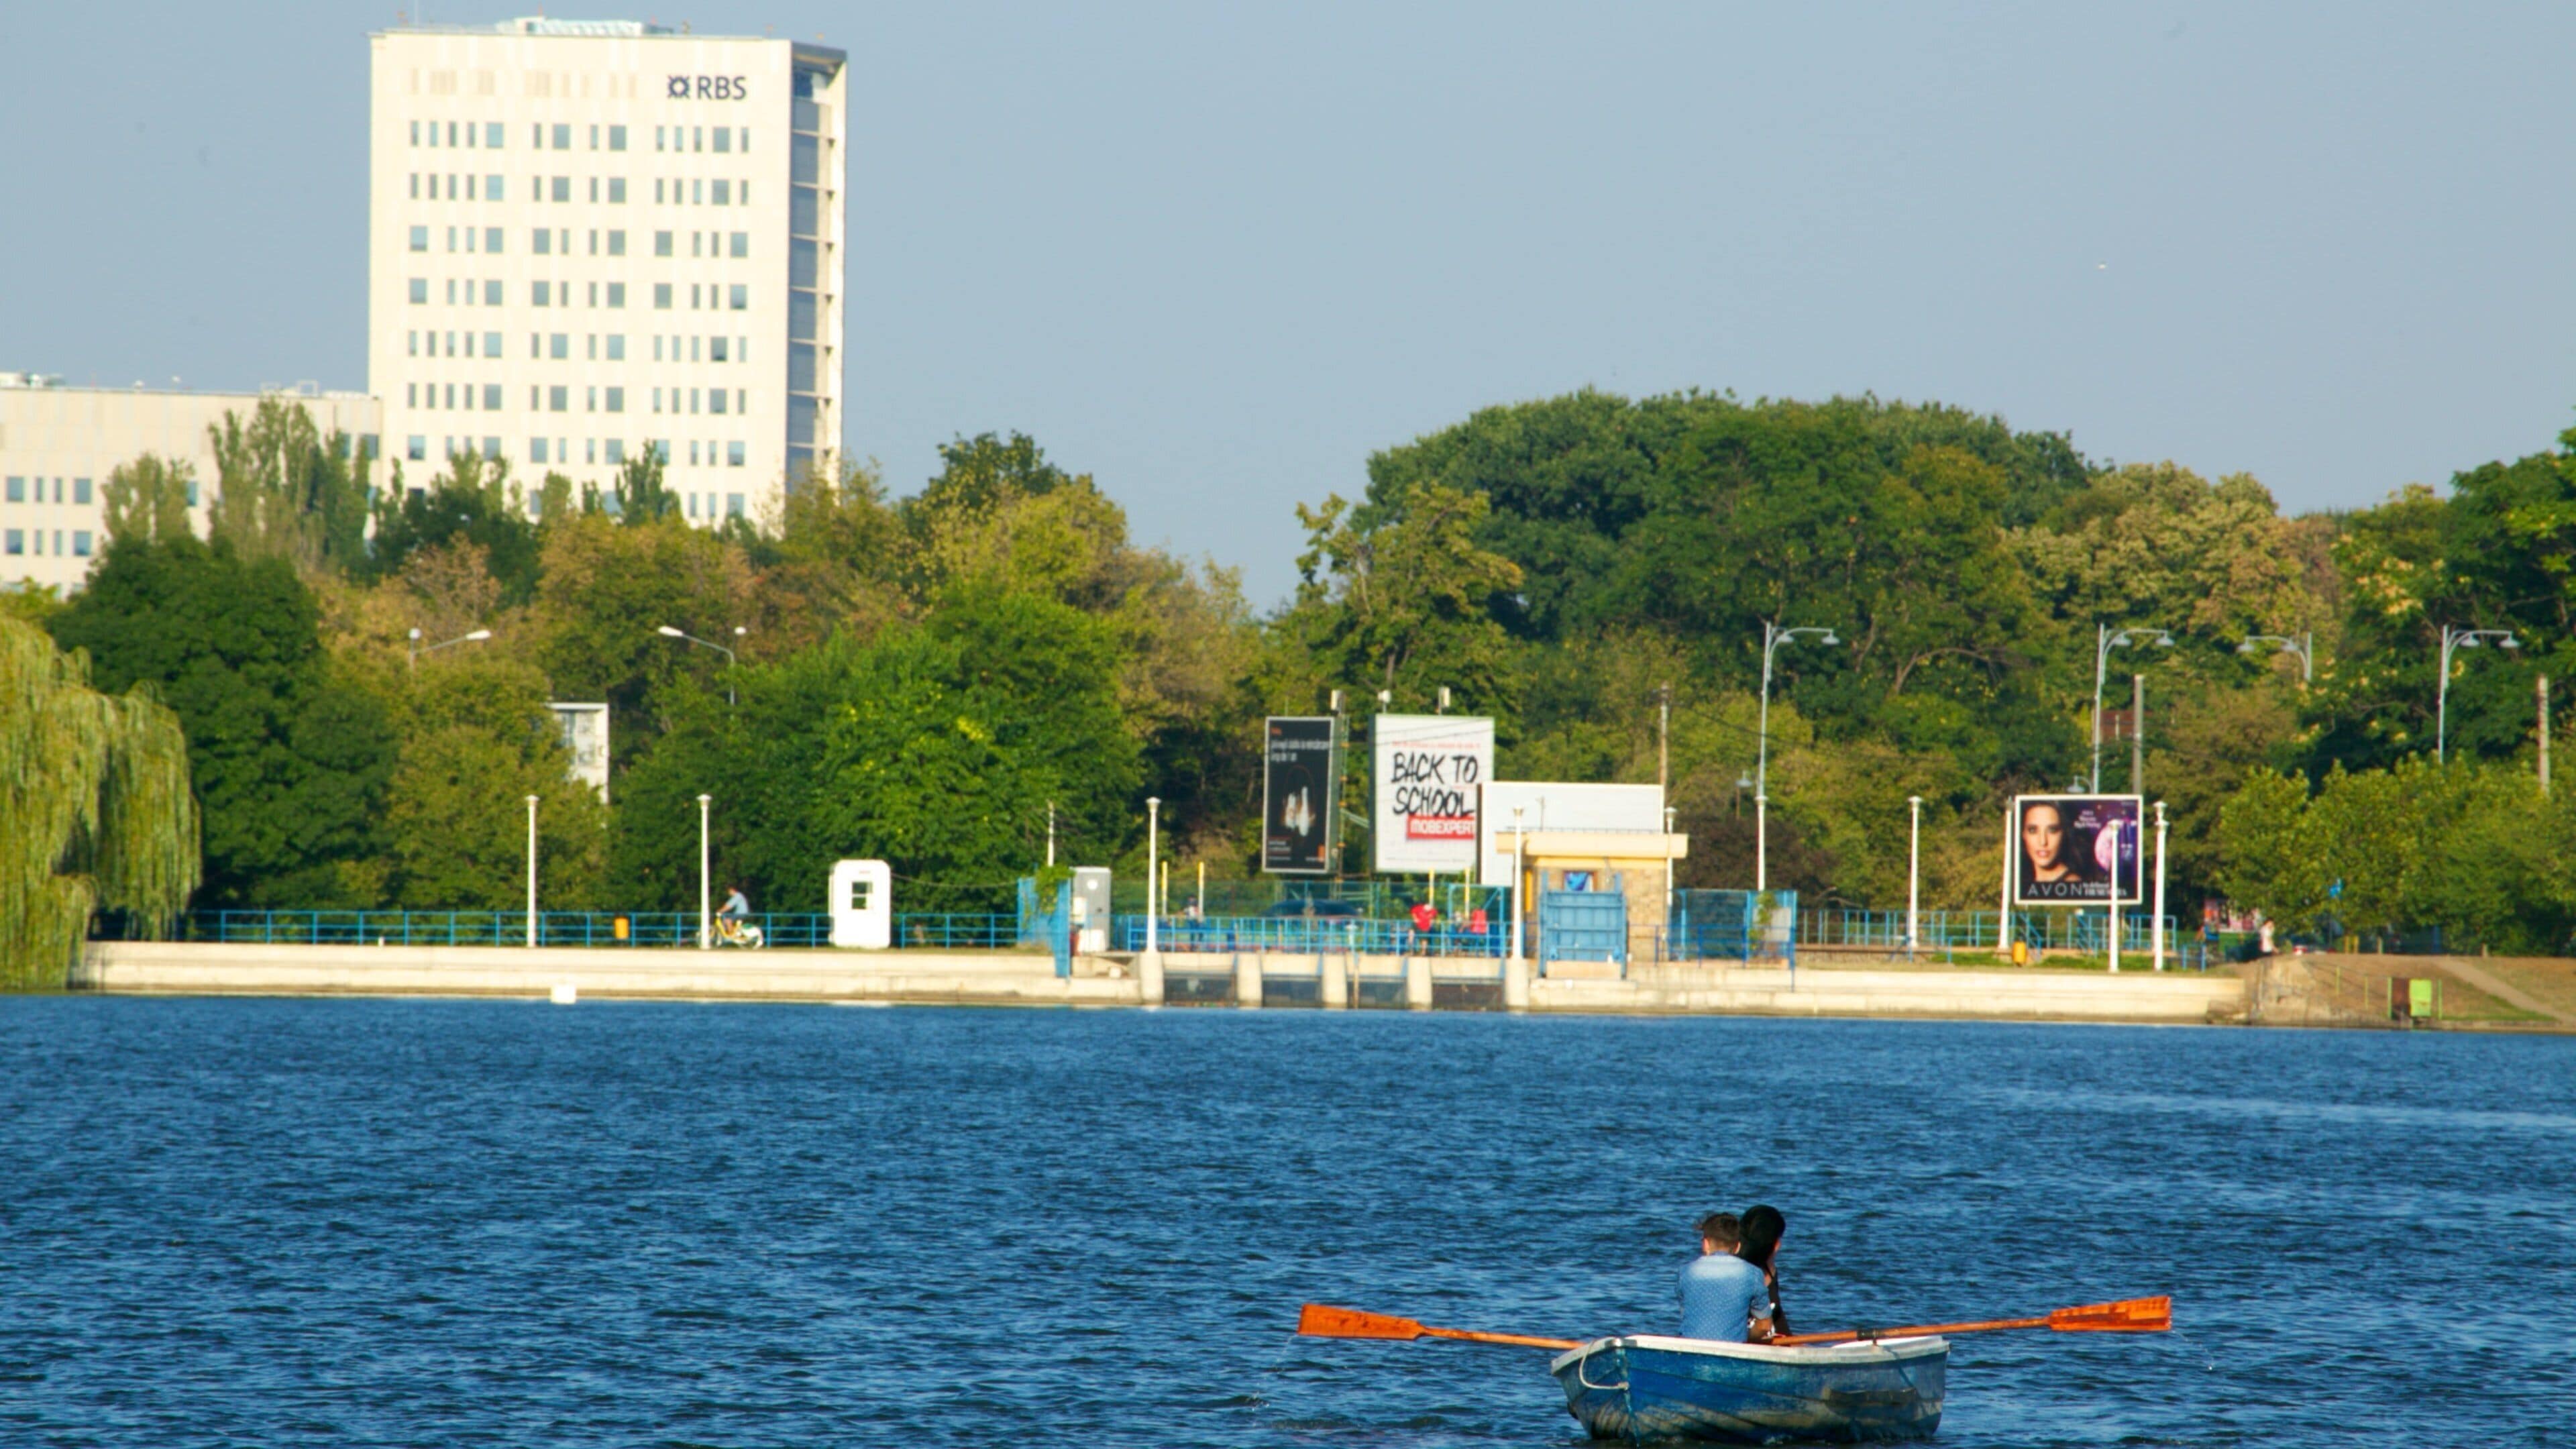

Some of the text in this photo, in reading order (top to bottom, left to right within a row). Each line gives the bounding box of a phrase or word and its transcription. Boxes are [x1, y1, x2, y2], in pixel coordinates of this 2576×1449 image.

[697, 75, 746, 101] RBS
[1391, 751, 1479, 784] BACK TO
[1393, 786, 1475, 818] SCHOOL
[2027, 882, 2082, 897] AVON
